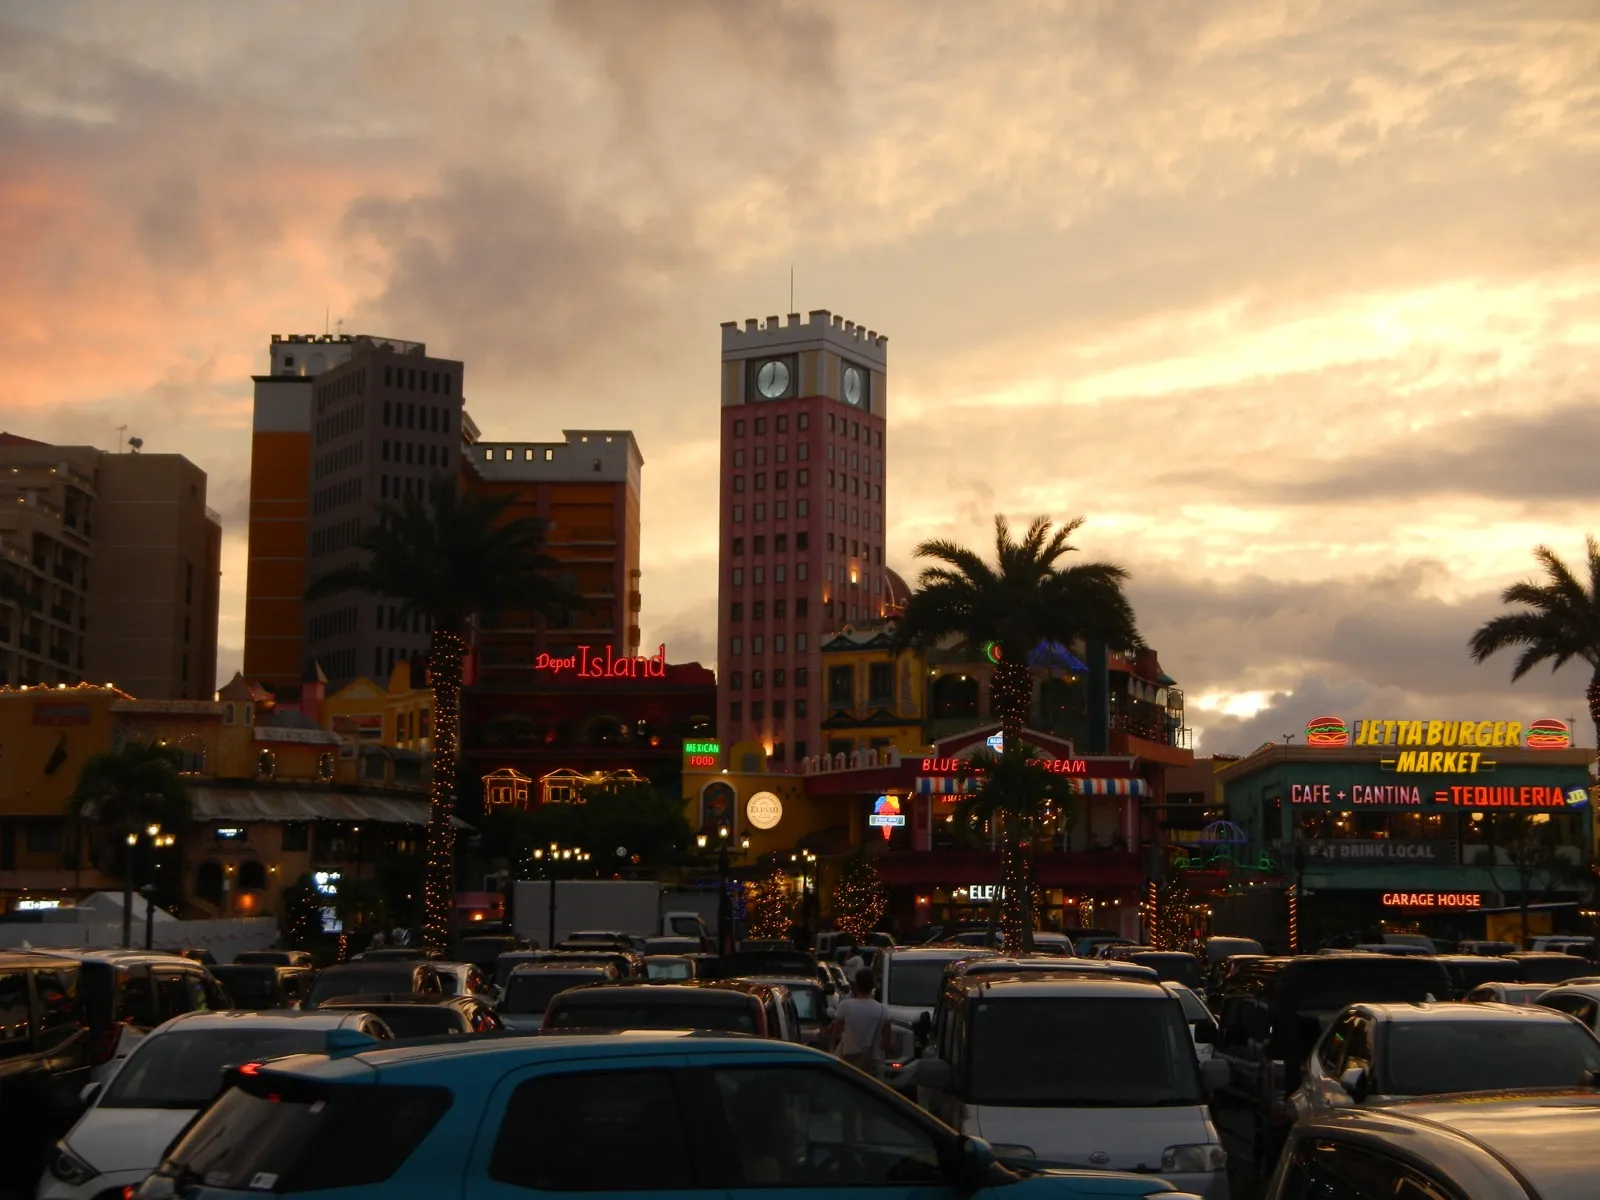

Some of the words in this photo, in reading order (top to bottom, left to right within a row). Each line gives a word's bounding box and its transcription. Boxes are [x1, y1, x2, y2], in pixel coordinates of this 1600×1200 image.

[535, 652, 576, 673] Depot
[577, 643, 666, 678] Island
[1355, 719, 1423, 746] JETTA
[1425, 720, 1522, 747] BURGER
[685, 743, 720, 753] MEXICAN
[691, 756, 714, 766] FOOD
[922, 758, 959, 772] BLUE
[1032, 759, 1087, 773] REAM
[1396, 751, 1481, 773] MARKET
[1291, 784, 1331, 804] CAFE
[1352, 784, 1421, 805] CANTINA
[1450, 785, 1565, 807] TEQUILERIA
[1340, 843, 1385, 857] DRINK
[1388, 844, 1436, 858] LOCAL
[1382, 893, 1435, 906] GARAGE
[1438, 894, 1481, 907] HOUSE
